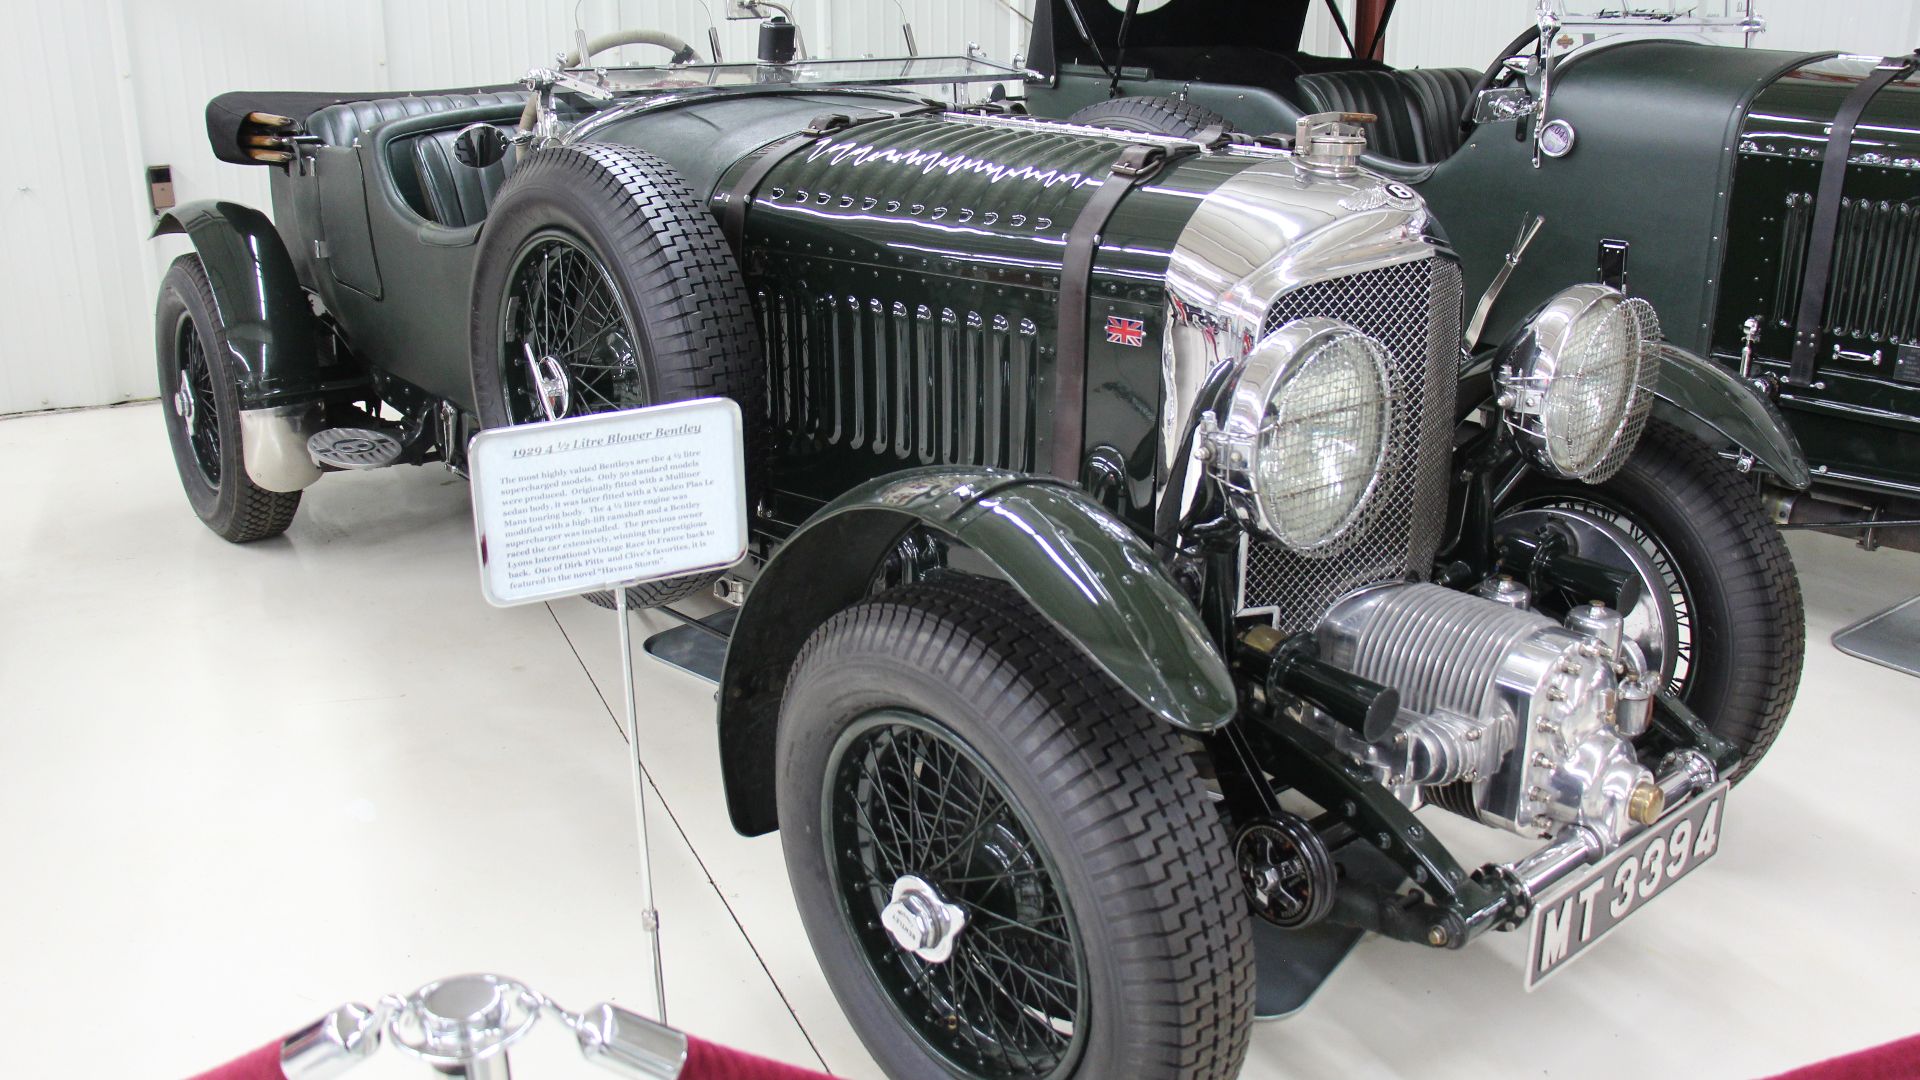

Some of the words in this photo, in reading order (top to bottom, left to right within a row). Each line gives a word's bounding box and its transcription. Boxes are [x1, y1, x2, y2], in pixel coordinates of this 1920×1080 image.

[1389, 184, 1412, 198] B
[512, 446, 542, 457] 1929
[544, 445, 553, 454] 4
[573, 438, 603, 448] Litre
[607, 432, 652, 443] Blower
[655, 424, 701, 436] Bentley
[500, 479, 558, 494] supercharged
[561, 475, 593, 485] models.
[597, 472, 616, 480] Only
[631, 463, 667, 475] standard
[670, 460, 699, 469] models
[518, 473, 538, 481] most
[541, 468, 566, 478] highly
[569, 463, 596, 474] valued
[599, 460, 634, 469] Bentleys
[502, 507, 527, 515] sedan
[529, 503, 552, 511] body,
[602, 491, 624, 500] fitted
[626, 488, 644, 496] with
[653, 483, 683, 492] Vanden
[524, 489, 567, 503] produced.
[571, 483, 612, 494] Originally
[614, 478, 636, 488] fitted
[639, 475, 656, 484] with
[665, 471, 700, 480] Mulliner
[505, 524, 542, 536] modified
[544, 521, 563, 530] with
[607, 509, 644, 520] camshaft
[646, 506, 661, 514] and
[670, 501, 700, 511] Bentley
[528, 513, 560, 522] touring
[562, 508, 584, 517] body.
[643, 495, 669, 505] engine
[505, 534, 561, 547] supercharger
[582, 523, 618, 535] installed.
[641, 516, 675, 527] previous
[506, 547, 529, 557] raced
[562, 535, 610, 548] extensively,
[613, 530, 646, 540] winning
[662, 521, 706, 534] prestigious
[508, 560, 532, 568] Lyons
[534, 548, 590, 563] International
[592, 545, 623, 554] Vintage
[657, 535, 685, 543] France
[686, 529, 704, 538] back
[508, 568, 530, 578] back.
[564, 559, 582, 568] Dirk
[607, 553, 622, 561] and
[652, 544, 690, 554] favorites,
[510, 576, 545, 588] featured
[573, 568, 595, 578] novel
[1540, 876, 1605, 972] MT
[1610, 799, 1719, 919] 3394
